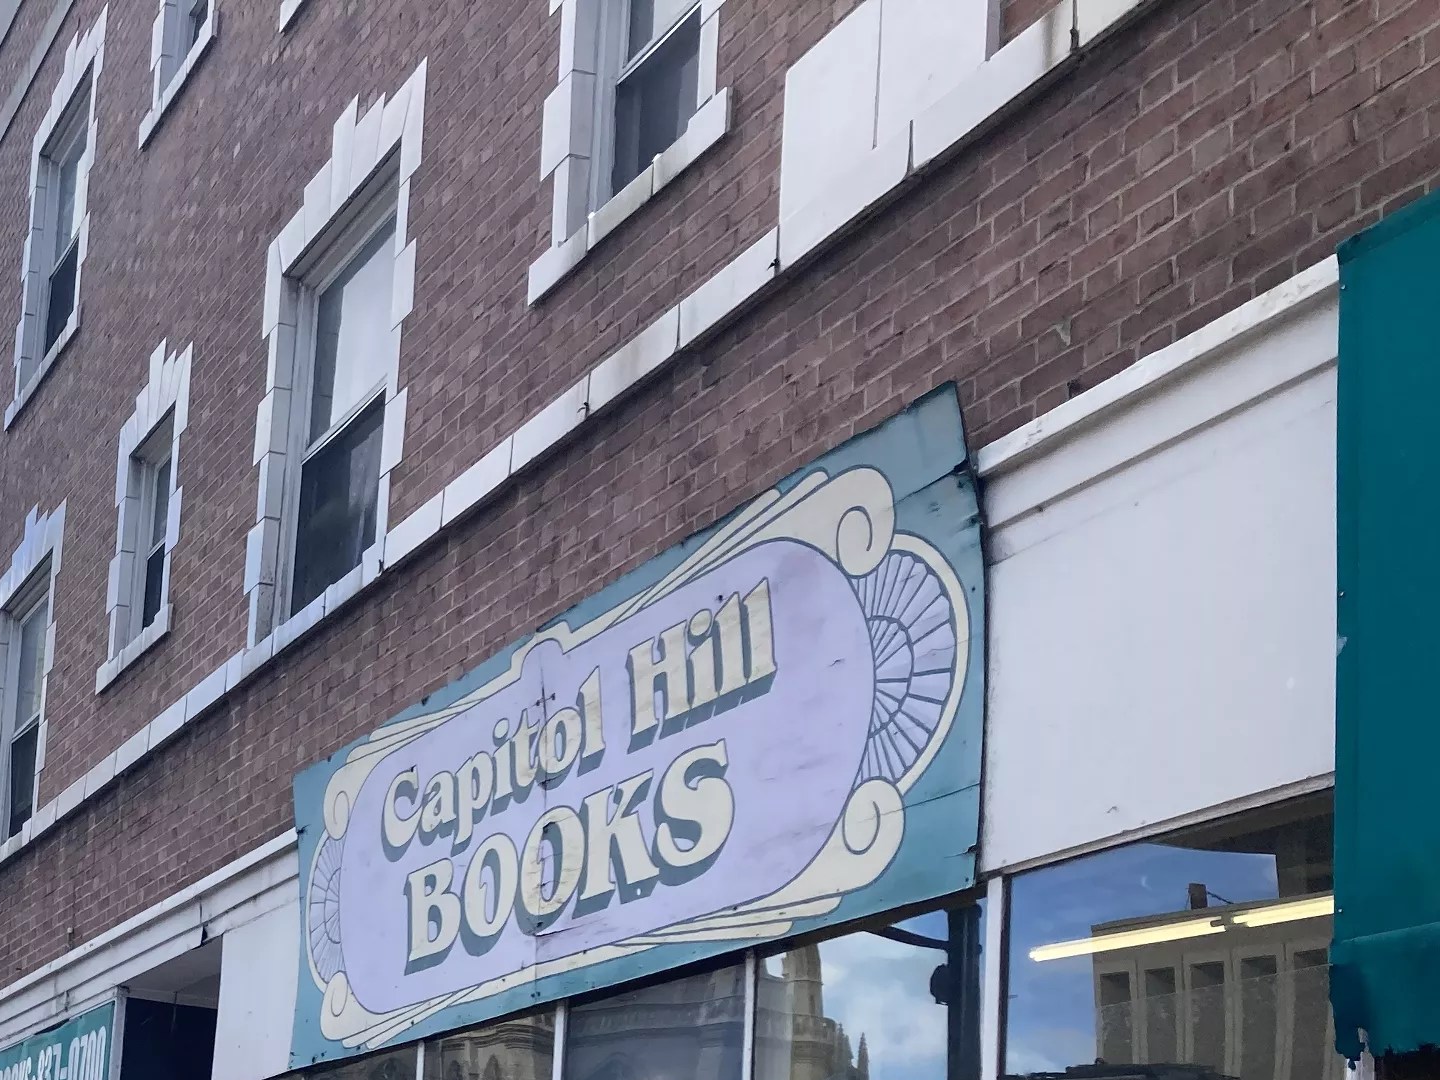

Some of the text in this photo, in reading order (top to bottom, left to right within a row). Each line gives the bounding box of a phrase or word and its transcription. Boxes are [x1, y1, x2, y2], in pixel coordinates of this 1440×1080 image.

[381, 577, 778, 862] Capitol Hill
[404, 738, 735, 976] BOOKS
